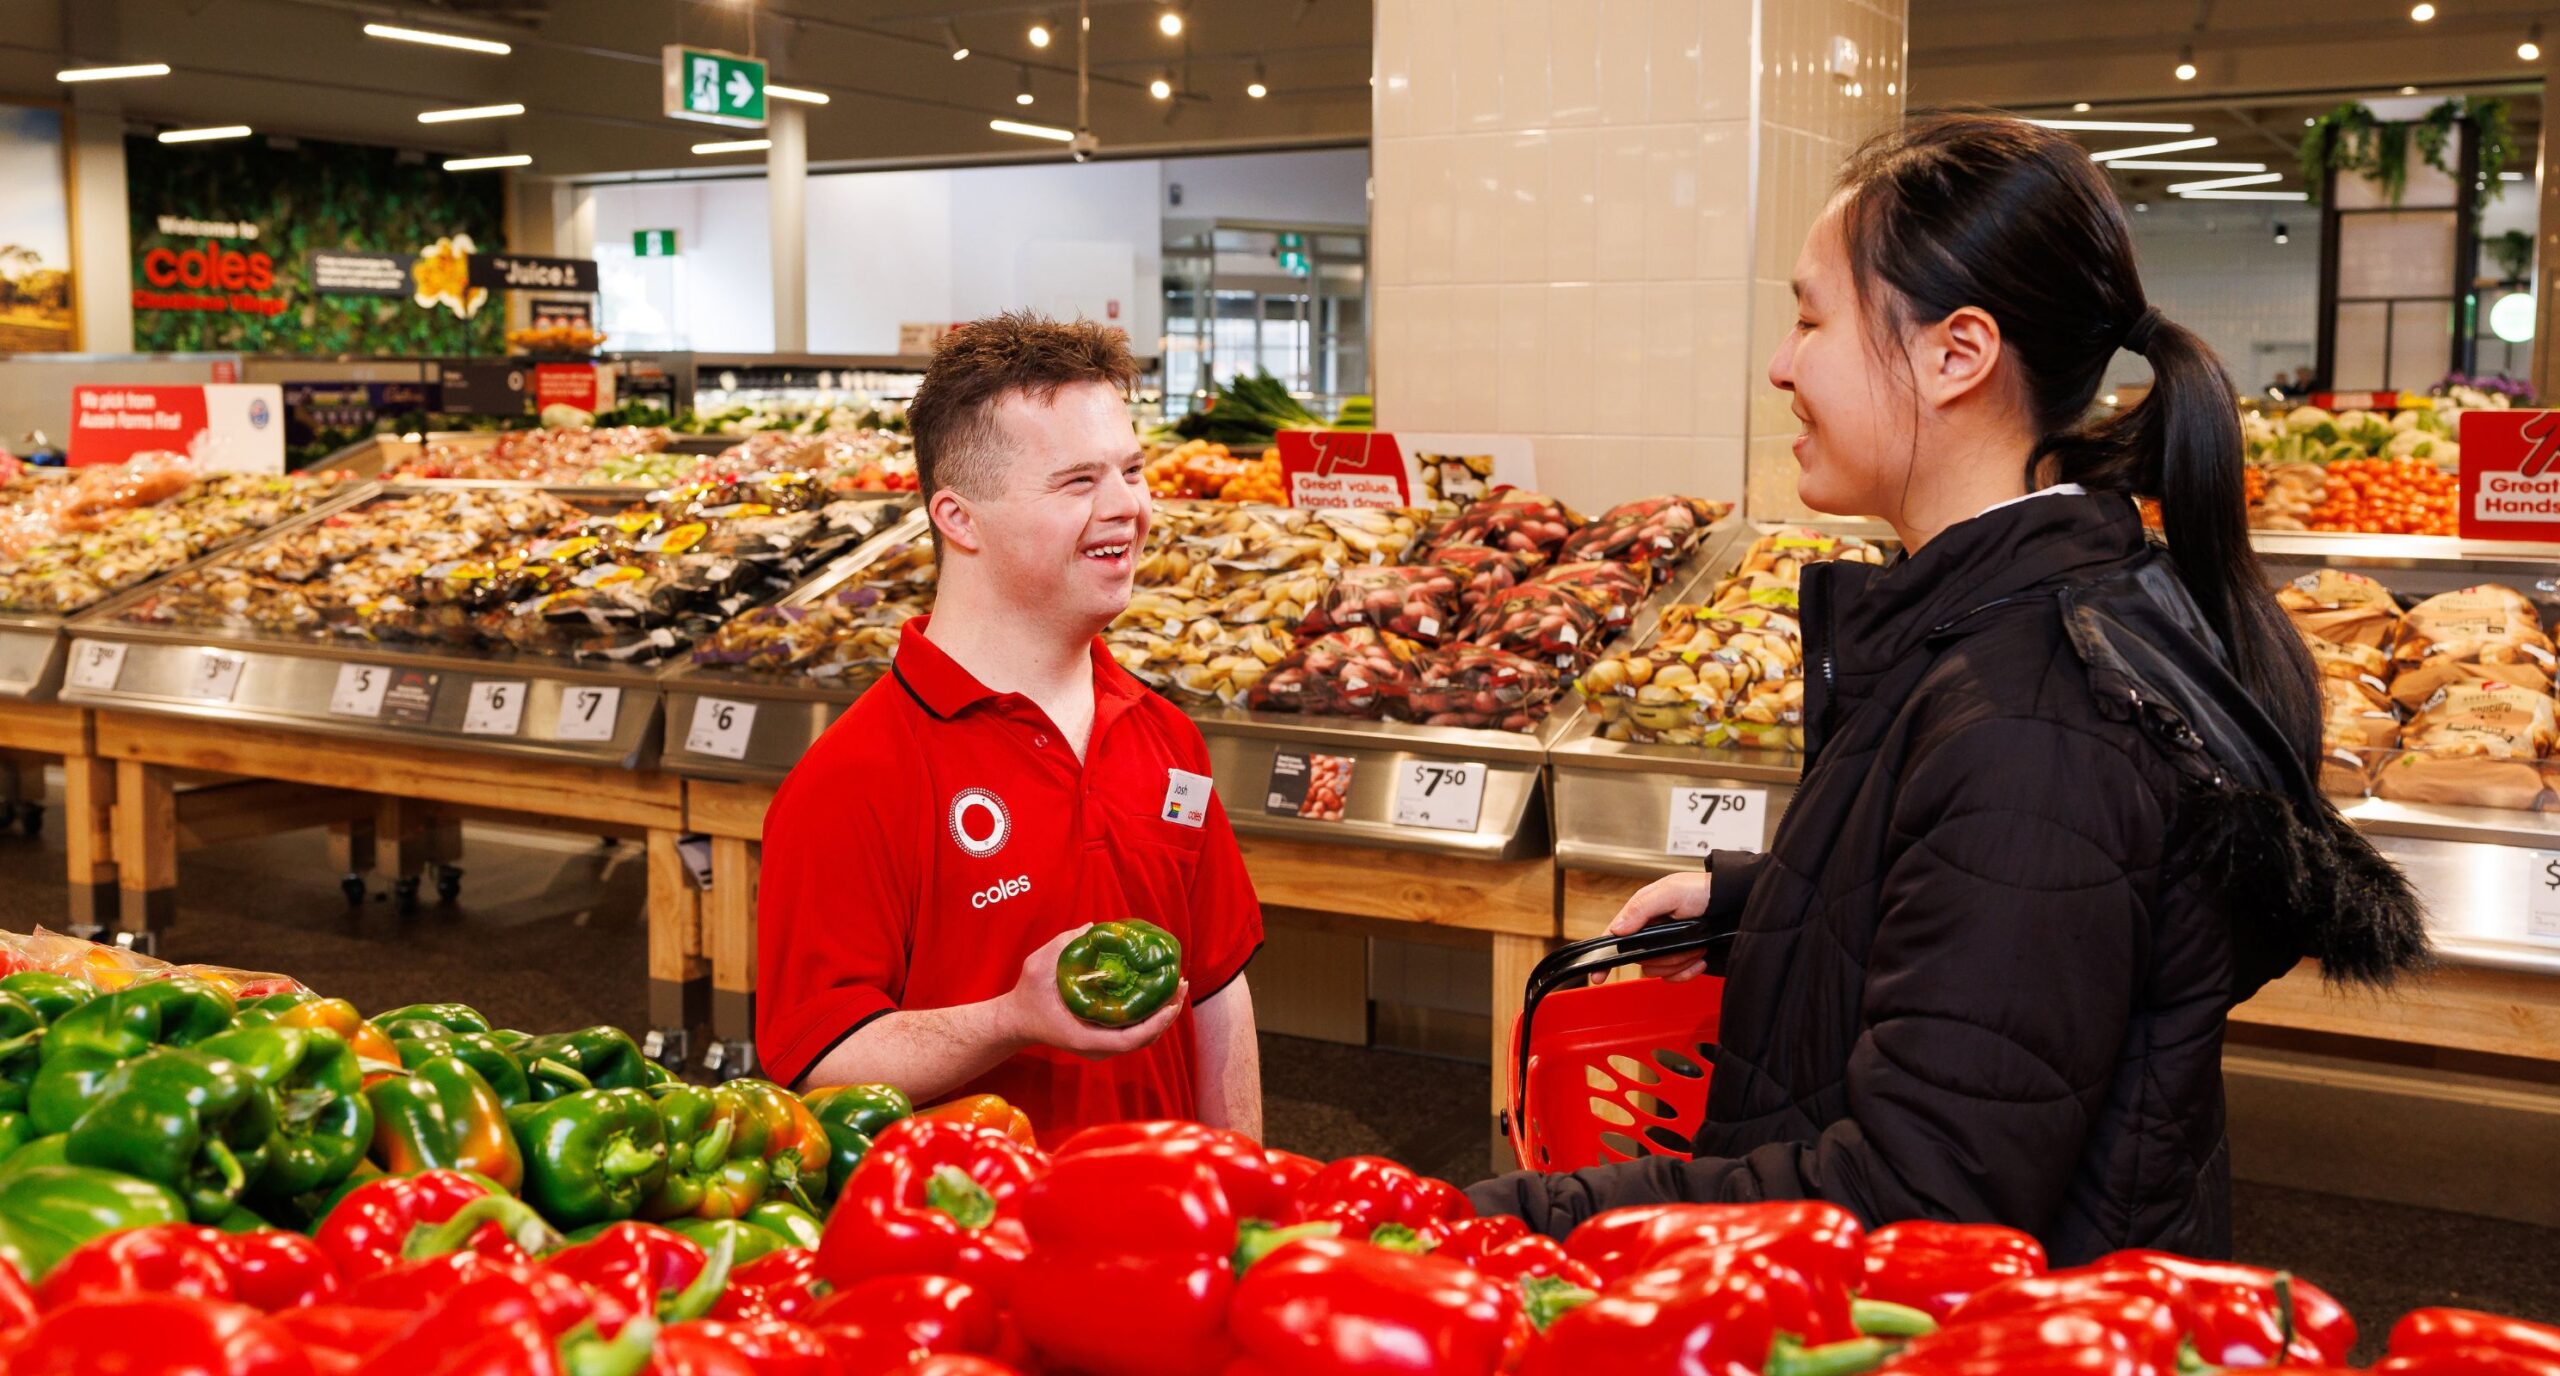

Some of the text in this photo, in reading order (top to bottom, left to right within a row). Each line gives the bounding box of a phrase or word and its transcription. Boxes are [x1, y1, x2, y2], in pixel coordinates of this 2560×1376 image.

[145, 240, 273, 290] coles
[1299, 478, 1341, 491] Great
[2490, 477, 2559, 493] Great
[1299, 494, 1347, 508] Hands
[2485, 498, 2560, 513] Hands
[577, 691, 602, 721] $7
[711, 703, 735, 731] $6
[971, 874, 1032, 909] coles
